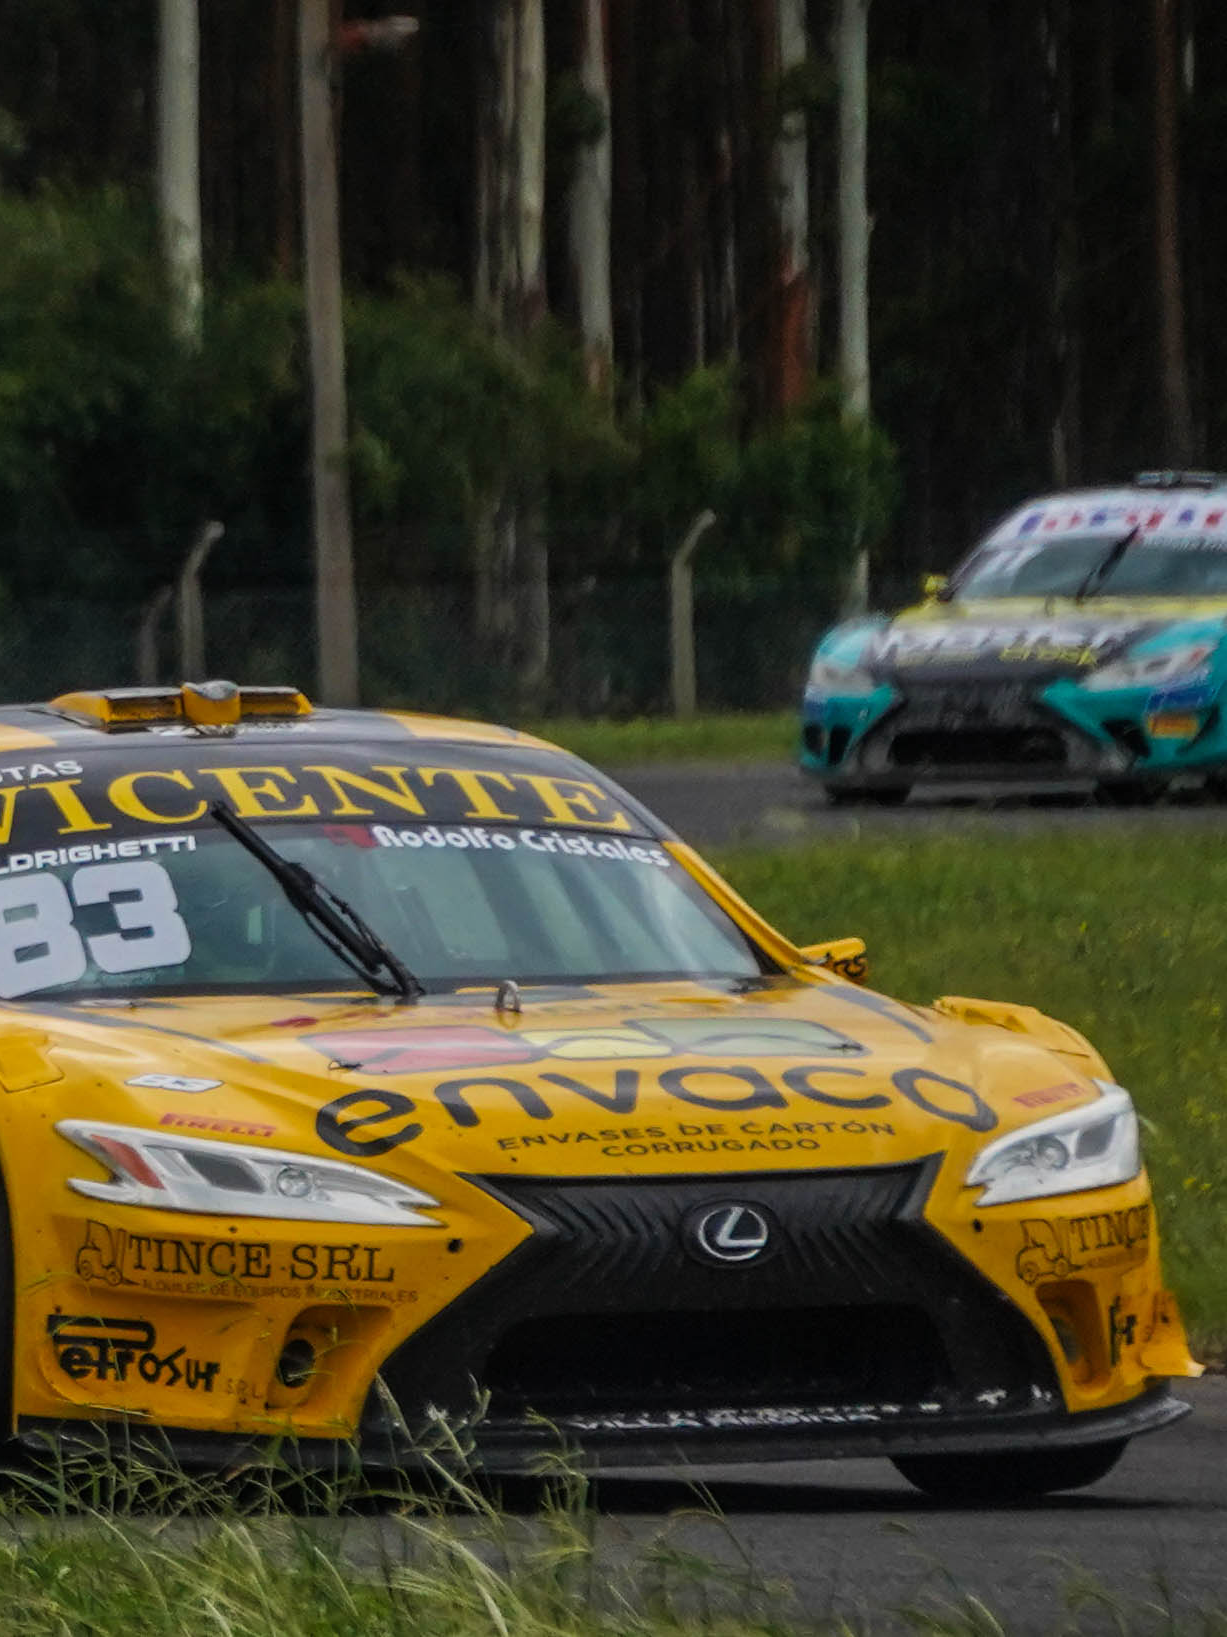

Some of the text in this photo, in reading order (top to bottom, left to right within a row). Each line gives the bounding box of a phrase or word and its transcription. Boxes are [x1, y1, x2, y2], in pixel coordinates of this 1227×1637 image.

[375, 825, 671, 868] Rodolfo Cristales
[159, 1112, 276, 1138] PIRELLI
[315, 1064, 999, 1157] envaco
[497, 1119, 897, 1152] ENVASES DE CARTÓN
[602, 1139, 821, 1157] CORRUGADO
[288, 1244, 395, 1283] SRL
